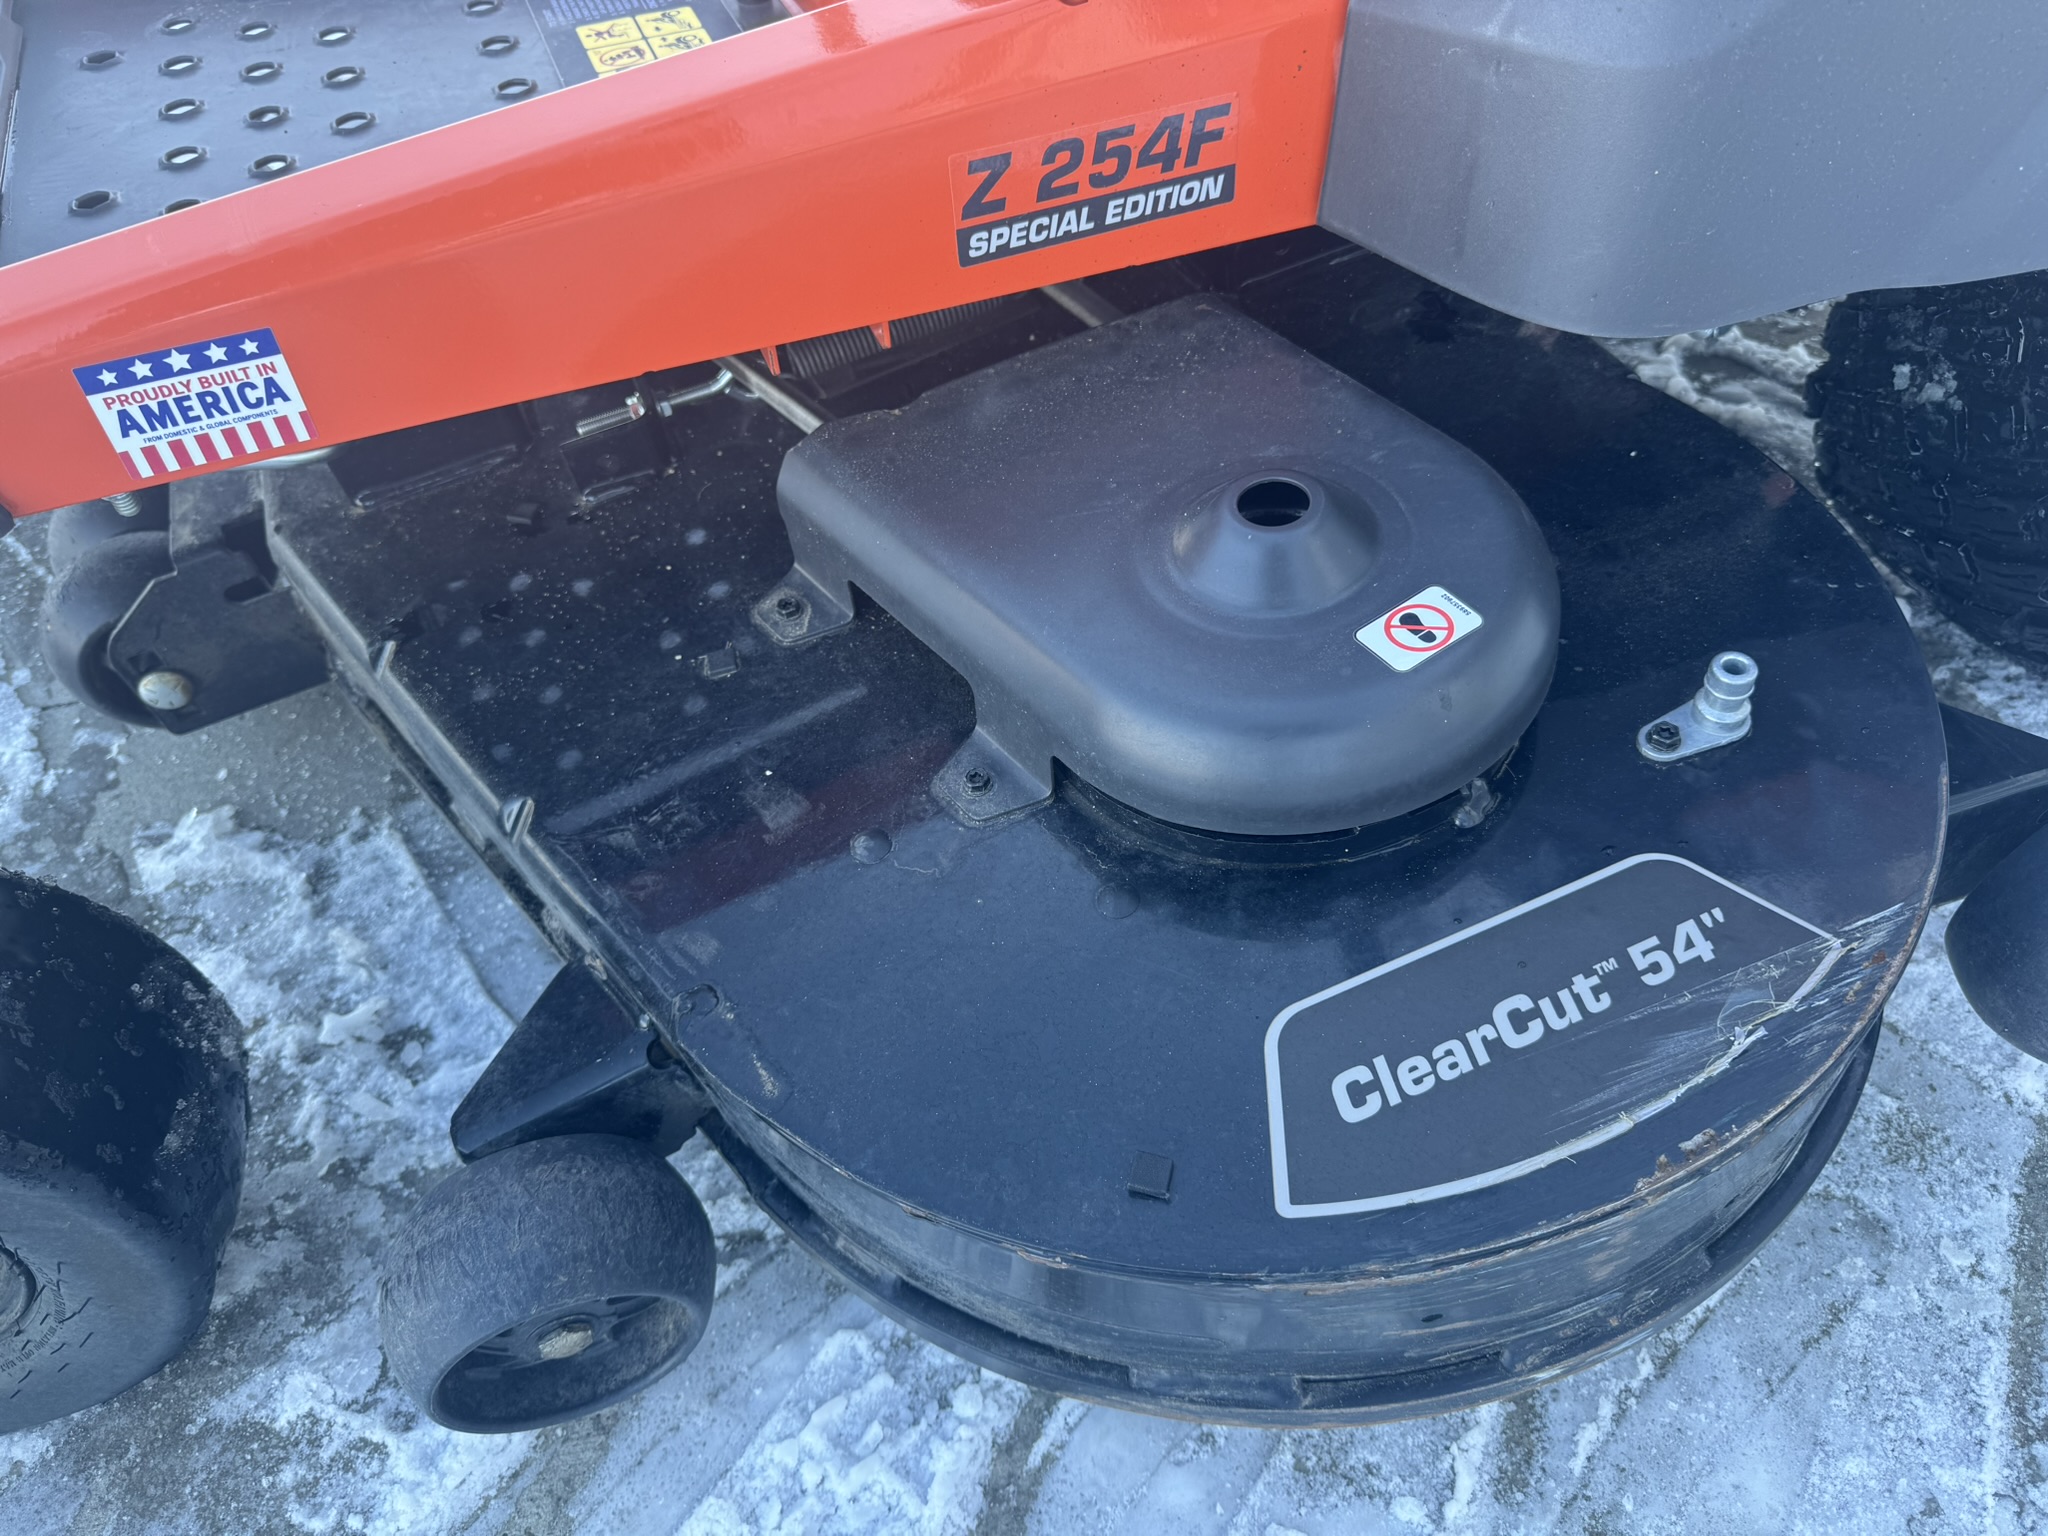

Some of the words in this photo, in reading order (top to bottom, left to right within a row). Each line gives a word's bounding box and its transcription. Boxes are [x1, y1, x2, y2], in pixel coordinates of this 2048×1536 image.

[961, 152, 1013, 221] Z
[1036, 103, 1231, 203] 254F
[968, 206, 1095, 258] SPECIAL
[1105, 174, 1225, 225] EDITION
[102, 380, 193, 410] PROUDLY
[198, 367, 251, 390] BUILT
[256, 361, 278, 378] IN
[116, 376, 292, 438] AMERICA
[143, 435, 163, 445] FROM
[164, 427, 199, 440] DOMESTIC
[206, 418, 232, 430] GLOBAL
[233, 409, 279, 424] COMPONENTS
[1626, 906, 1725, 986] 54"
